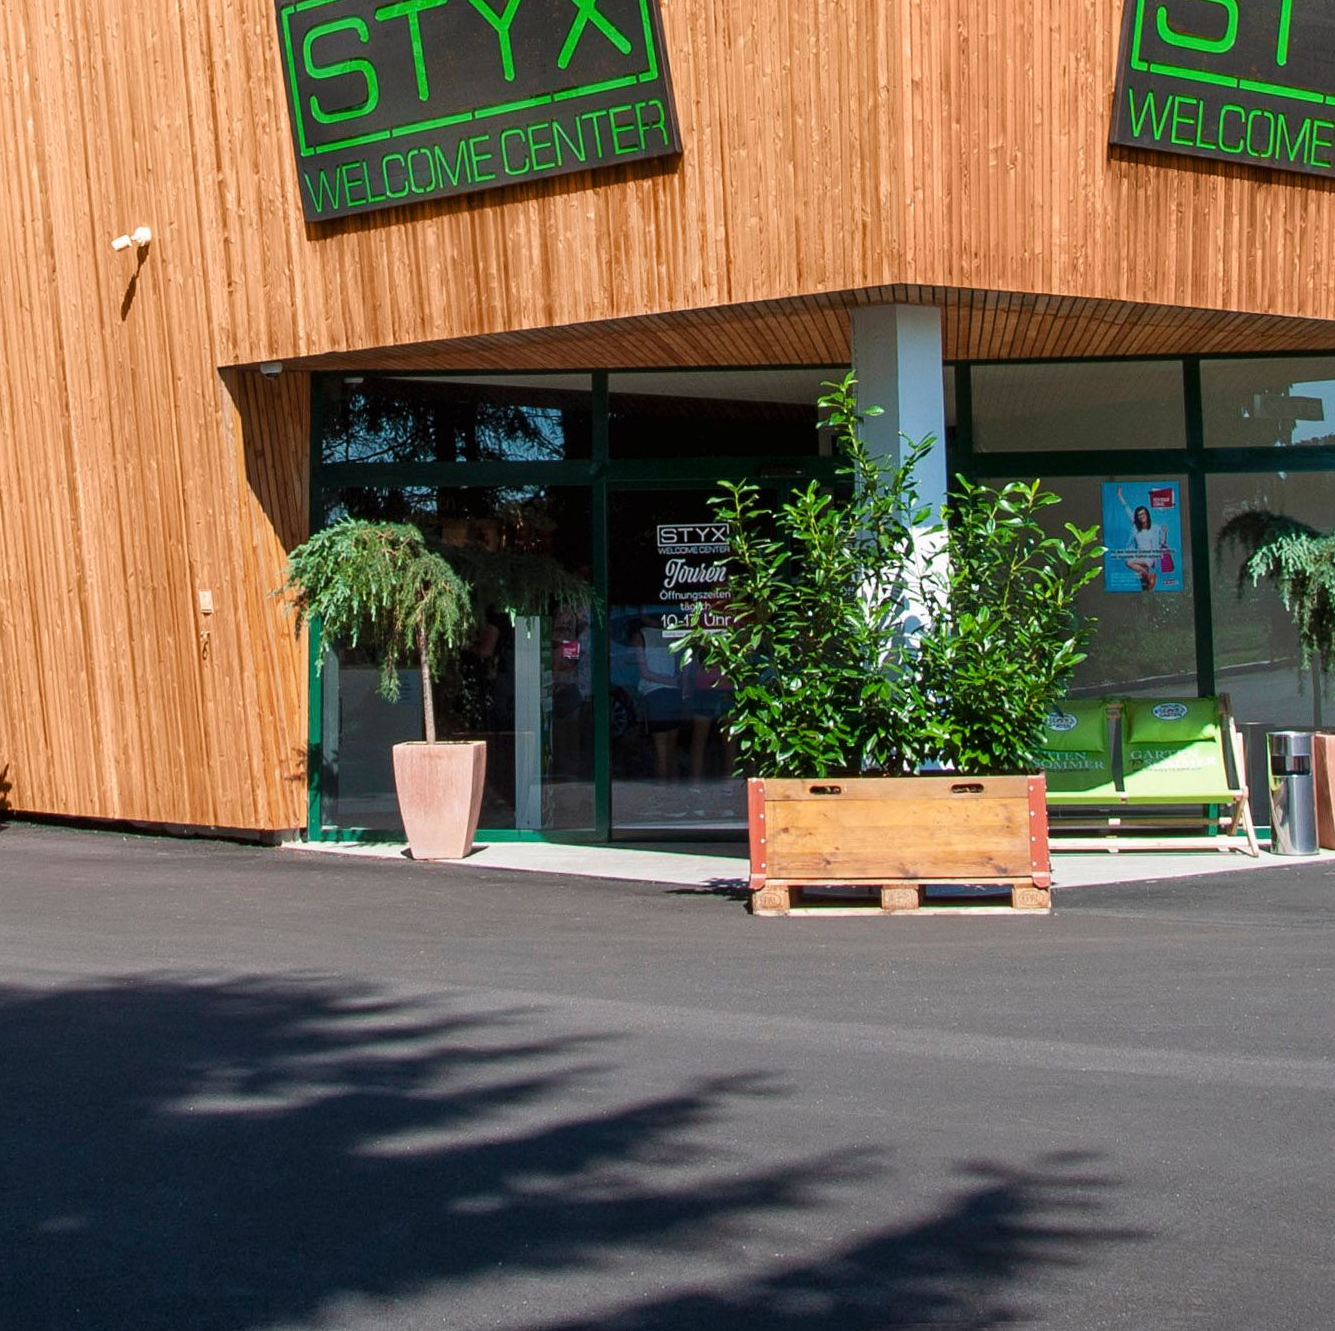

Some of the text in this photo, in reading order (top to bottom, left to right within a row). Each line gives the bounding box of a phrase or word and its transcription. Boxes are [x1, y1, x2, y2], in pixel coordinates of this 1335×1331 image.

[1129, 88, 1335, 168] WELCOME
[304, 99, 669, 213] WELCOME CENTER
[661, 528, 726, 543] STYX
[658, 546, 731, 555] WELCOME CENTER
[664, 558, 727, 588] Touren
[659, 590, 731, 601] Öffnungszeiten
